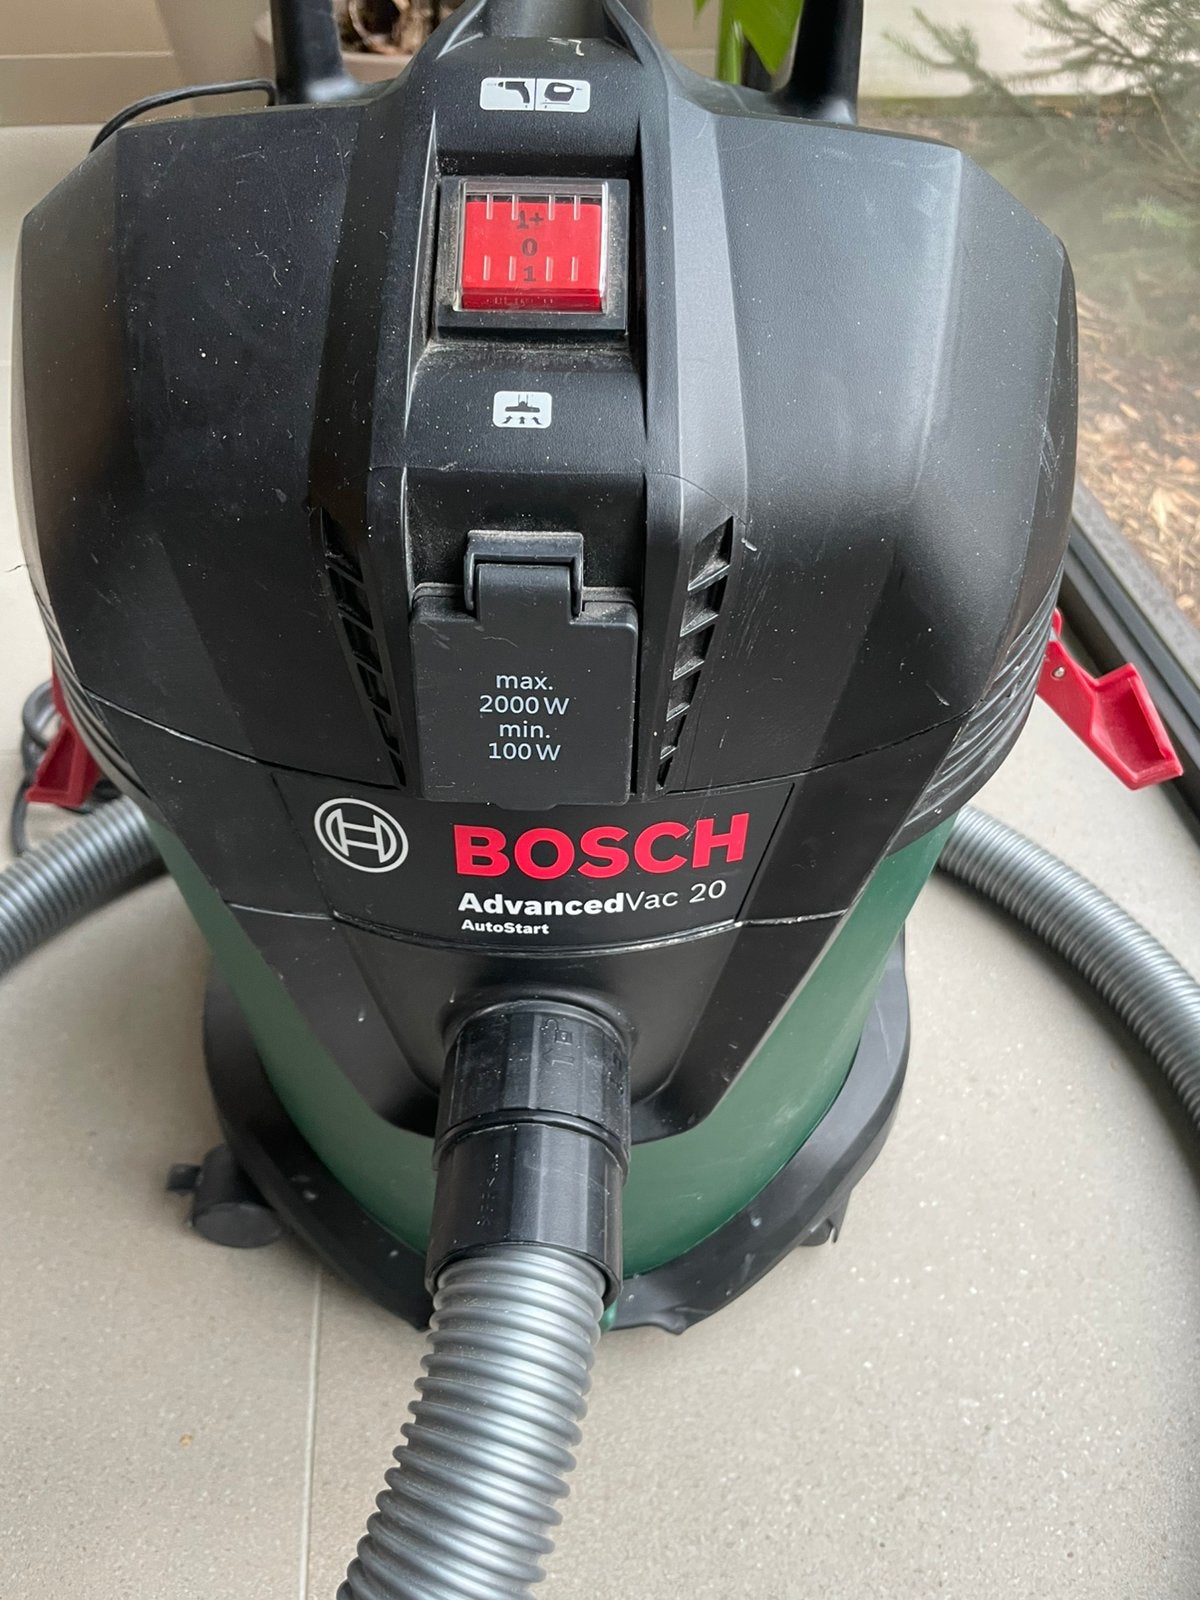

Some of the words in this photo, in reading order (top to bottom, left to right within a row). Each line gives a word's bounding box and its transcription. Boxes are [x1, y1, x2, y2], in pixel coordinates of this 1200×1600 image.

[522, 238, 538, 256] 0
[523, 266, 536, 282] 1
[496, 674, 553, 690] max.
[499, 720, 550, 738] min.
[453, 813, 750, 880] BOSCH
[457, 890, 679, 916] AdvancedVac
[688, 879, 727, 904] 20
[461, 919, 550, 935] AutoStart
